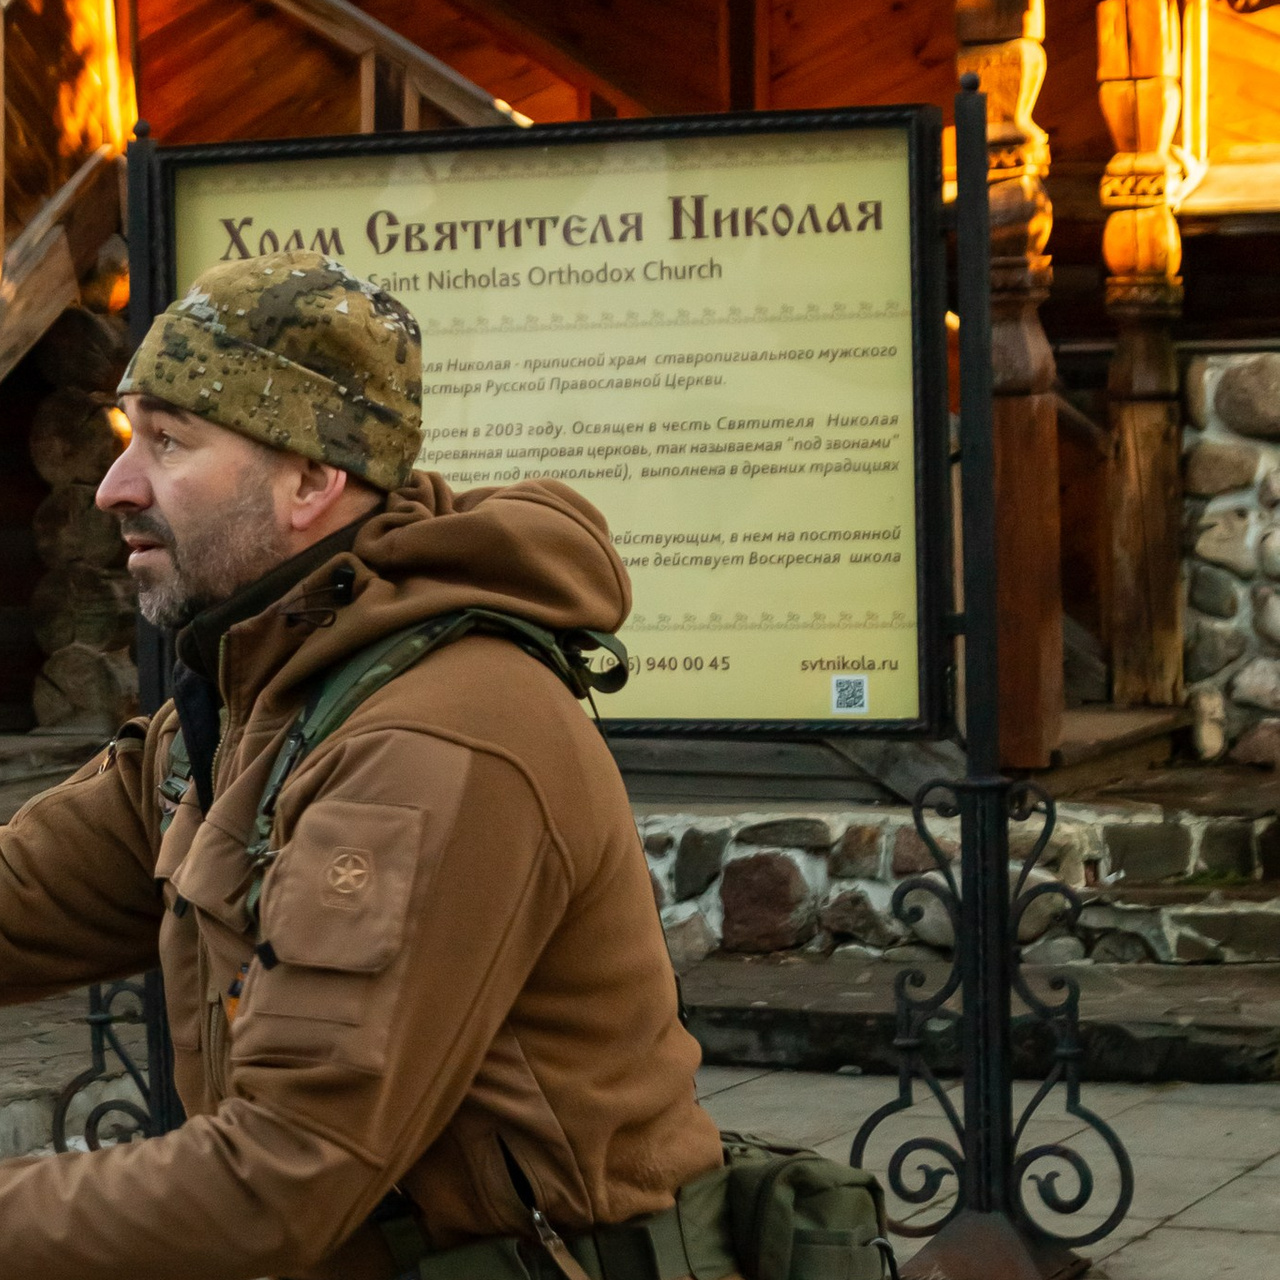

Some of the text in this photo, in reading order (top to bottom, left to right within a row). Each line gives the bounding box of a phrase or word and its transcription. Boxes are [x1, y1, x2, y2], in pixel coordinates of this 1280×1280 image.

[366, 209, 644, 256] Святителя
[667, 194, 883, 241] Николая
[427, 267, 521, 292] Nicholas
[527, 262, 636, 287] Orthodox
[643, 256, 723, 282] Church
[446, 357, 512, 372] Николая
[522, 352, 606, 373] приписной
[608, 354, 648, 368] храм
[654, 347, 815, 368] ставропигиального
[817, 345, 898, 364] мужского
[484, 377, 546, 396] Русской
[549, 372, 662, 395] Православной
[664, 373, 727, 390] Церкви.
[472, 426, 481, 438] в
[484, 422, 523, 437] 2003
[528, 421, 567, 440] году.
[571, 420, 644, 437] Освящен
[648, 421, 657, 433] в
[661, 420, 712, 433] честь
[716, 415, 815, 431] Святителя
[826, 412, 900, 428] Николая
[505, 446, 584, 462] шатровая
[586, 443, 652, 460] церковь,
[656, 442, 687, 455] так
[690, 438, 783, 454] называемая
[493, 466, 521, 481] под
[640, 461, 727, 478] выполнена
[730, 463, 739, 476] в
[742, 459, 806, 478] древних
[810, 457, 900, 477] традициях
[730, 532, 739, 544] в
[742, 530, 773, 543] нем
[777, 530, 796, 542] на
[799, 525, 902, 542] постоянной
[653, 551, 745, 570] действует
[748, 550, 841, 568] Воскресная
[849, 551, 902, 564] школа
[646, 655, 678, 671] 940
[682, 655, 705, 671] 00
[708, 655, 731, 671] 45
[800, 654, 900, 671] svtnikola.ru
